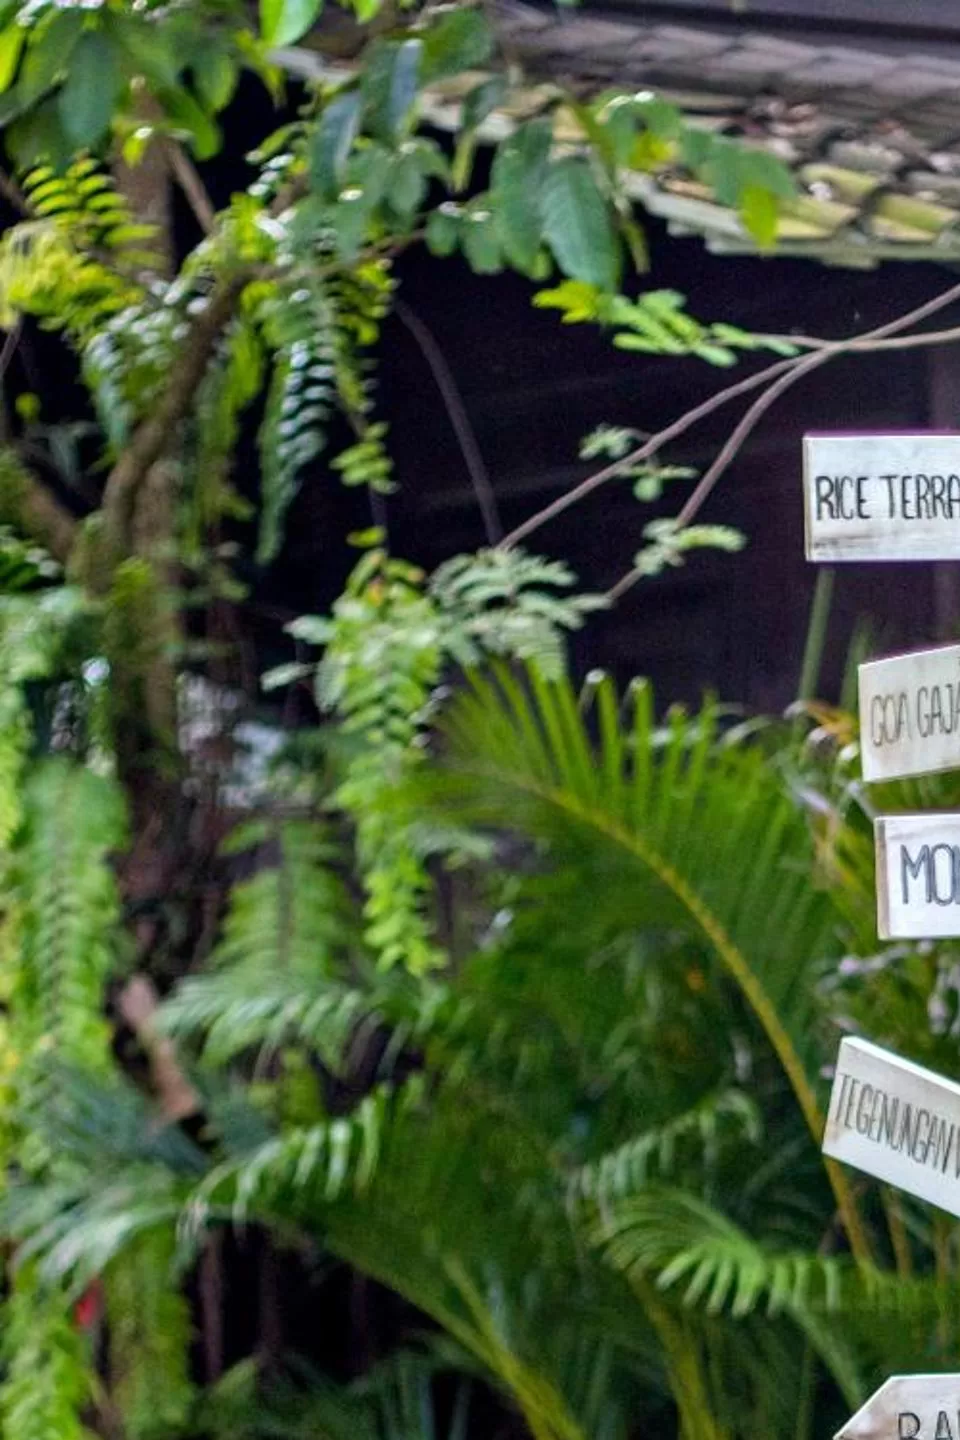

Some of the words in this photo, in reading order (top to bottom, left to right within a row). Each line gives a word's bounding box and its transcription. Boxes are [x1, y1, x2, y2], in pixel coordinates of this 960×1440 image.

[814, 475, 869, 520] RICE
[870, 692, 913, 747] GOA
[834, 1074, 955, 1174] TEGENUNGAN
